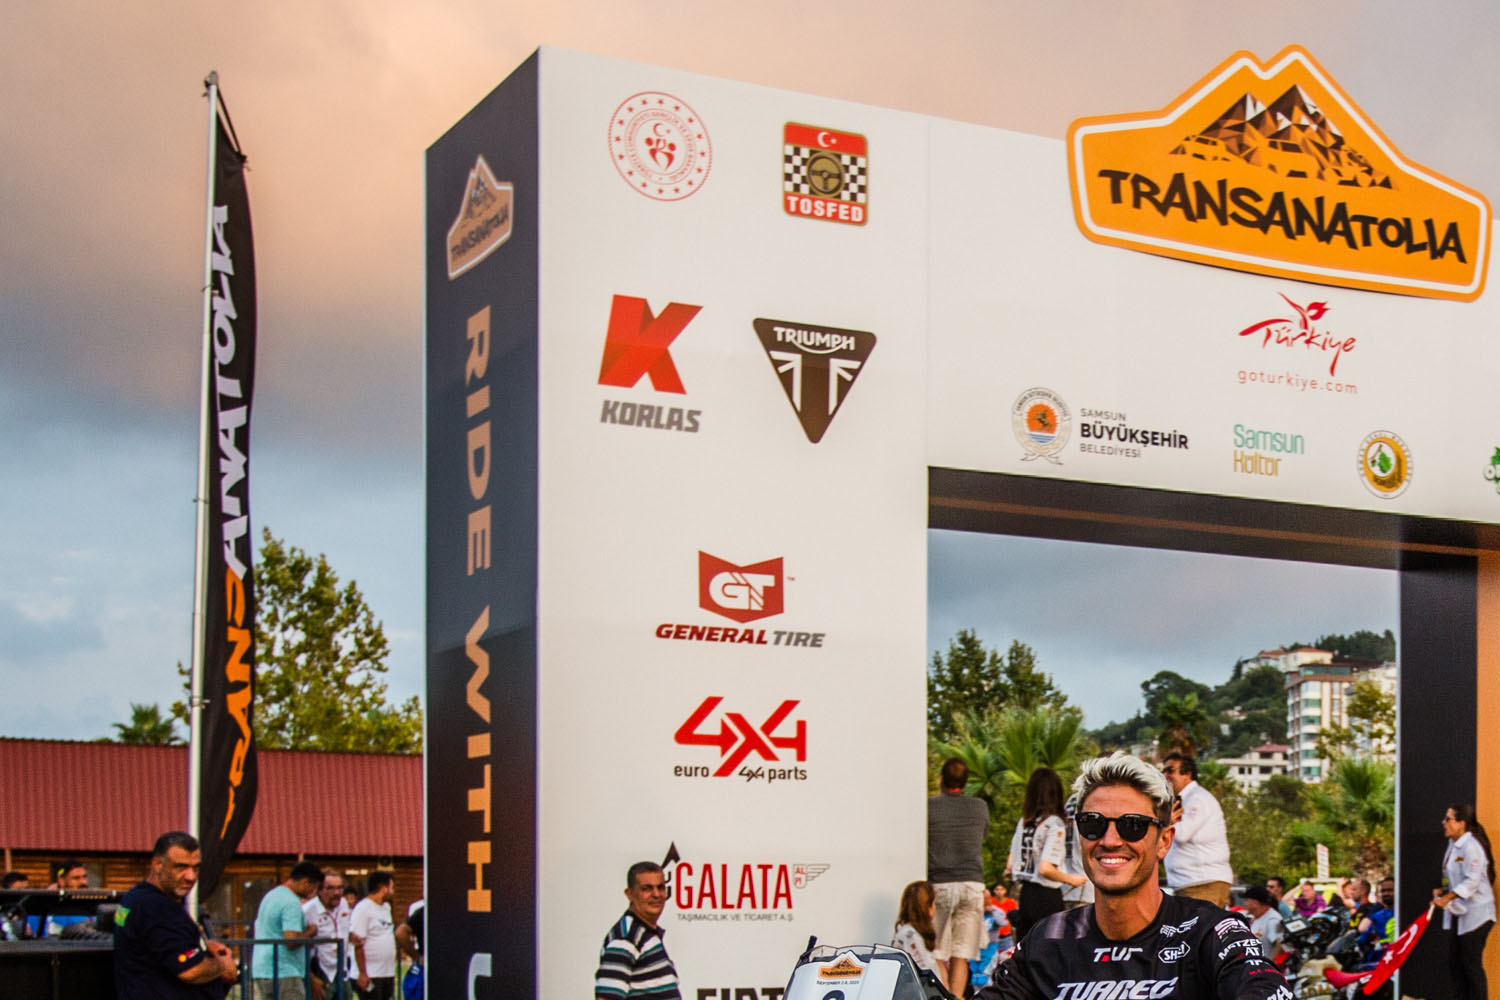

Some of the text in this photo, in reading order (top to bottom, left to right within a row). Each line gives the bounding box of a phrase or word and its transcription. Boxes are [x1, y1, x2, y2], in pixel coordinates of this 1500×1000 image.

[787, 195, 864, 223] TOSFED
[1098, 169, 1468, 263] TRANSANATOLIA
[773, 326, 856, 352] TRIUMPH
[1238, 369, 1359, 394] goturkiye.com
[600, 400, 702, 433] KORLAS
[1080, 407, 1127, 422] SAMSUN
[466, 304, 492, 576] RIDE
[1080, 421, 1189, 450] BÜYÜKŞEHİR
[1233, 424, 1305, 455] Samsun
[655, 623, 826, 648] GENERAL TIRE
[466, 604, 492, 912] WITH
[674, 765, 710, 778] euro
[768, 766, 808, 783] parts
[675, 862, 794, 910] GALATA
